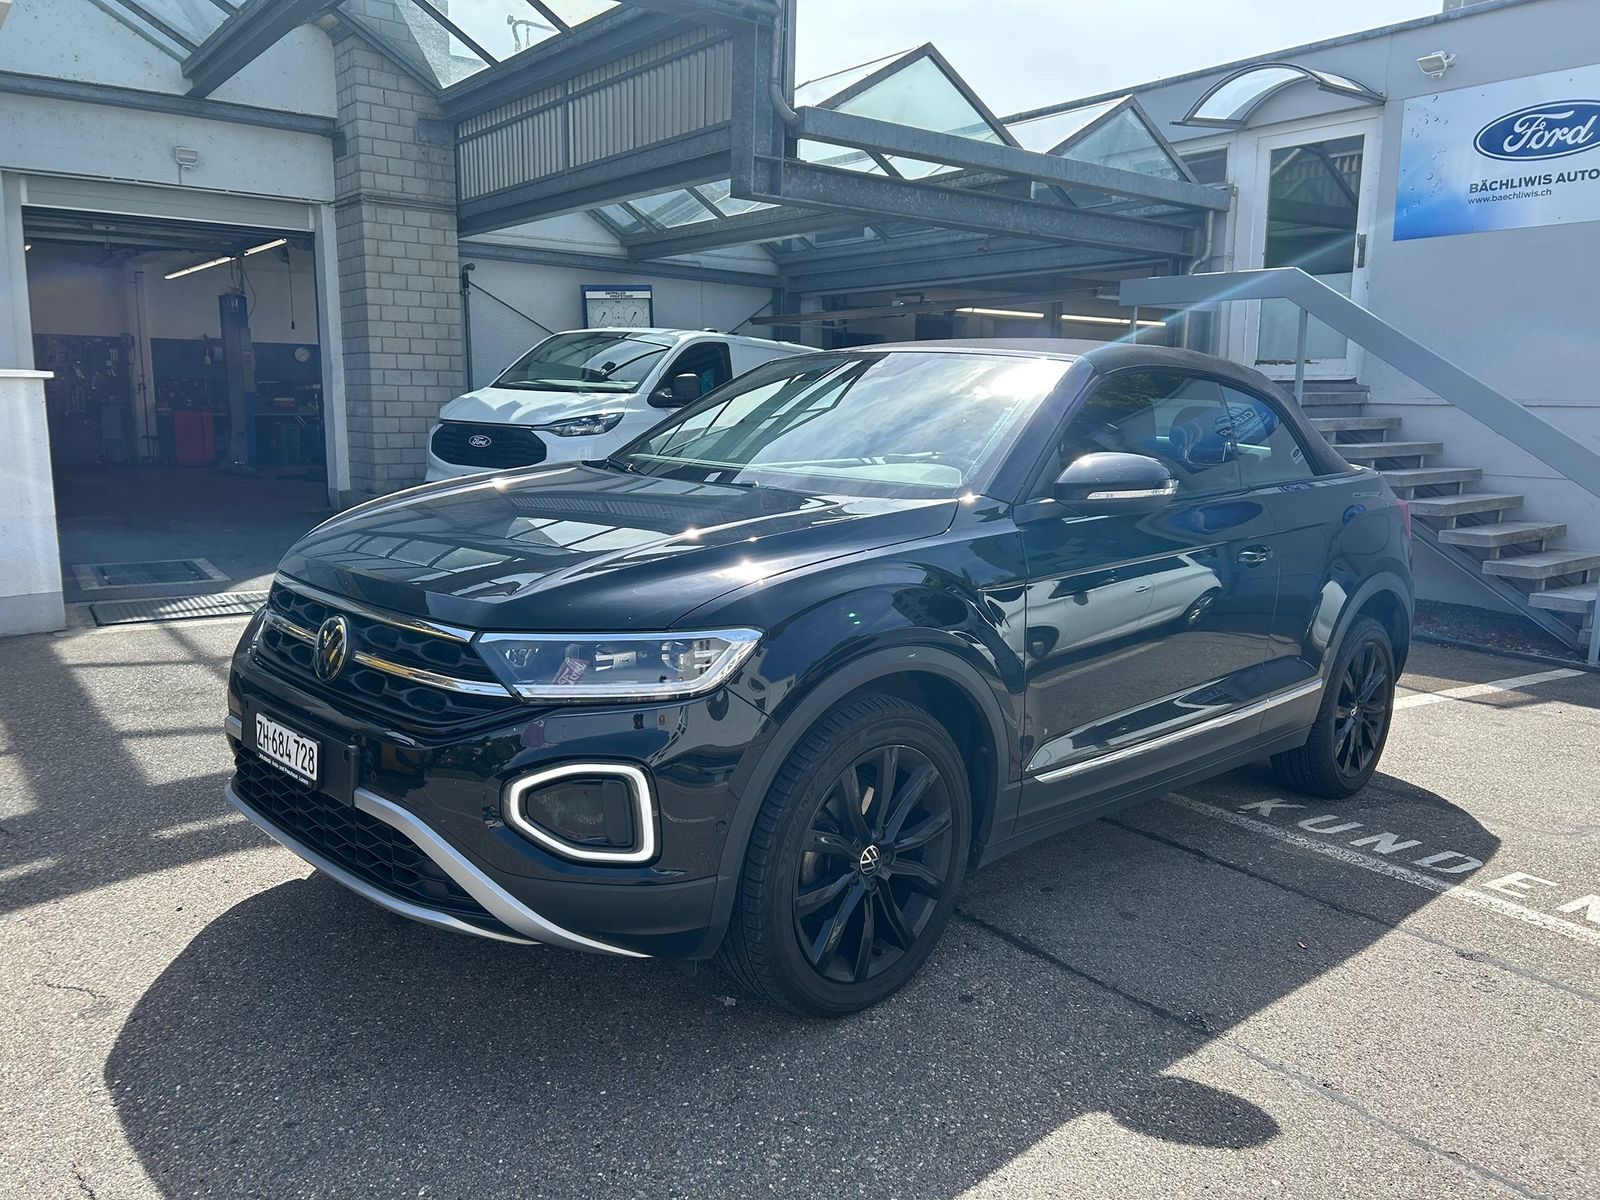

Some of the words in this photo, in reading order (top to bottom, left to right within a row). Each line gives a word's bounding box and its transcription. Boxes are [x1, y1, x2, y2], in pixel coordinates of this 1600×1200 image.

[1503, 110, 1599, 153] Ford
[1467, 187, 1552, 205] www.baechliwis.ch
[1469, 173, 1553, 194] BÄCHLIWIS
[1555, 168, 1600, 184] AUTO
[293, 738, 315, 775] 728
